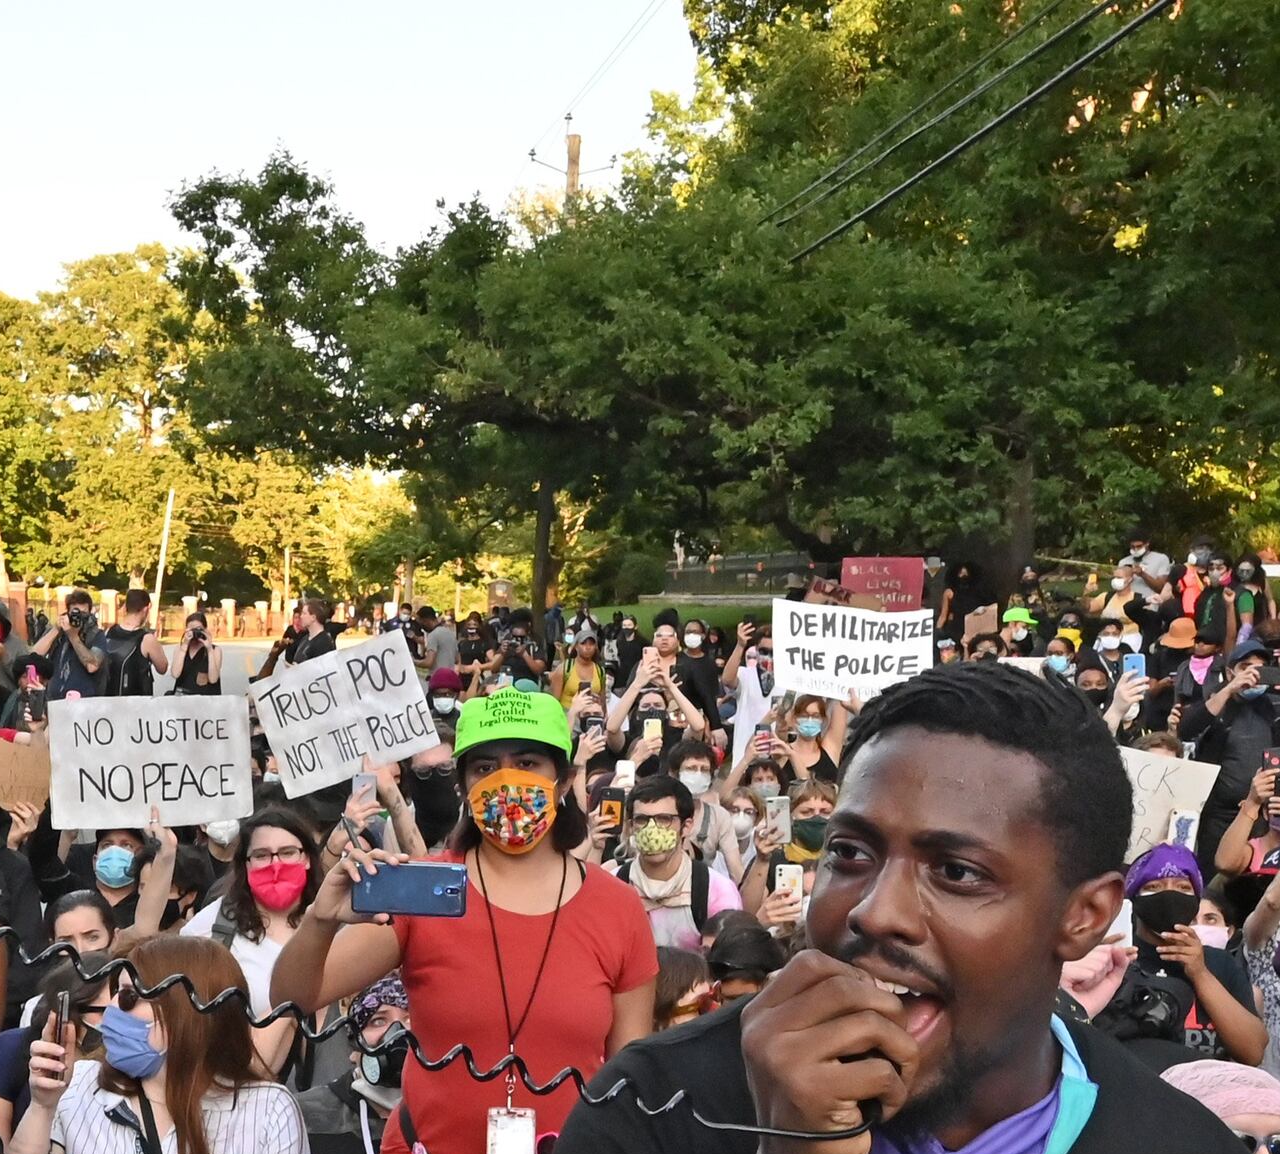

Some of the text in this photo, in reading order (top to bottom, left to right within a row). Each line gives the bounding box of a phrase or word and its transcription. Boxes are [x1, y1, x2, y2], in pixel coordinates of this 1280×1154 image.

[866, 579, 902, 590] LIVES
[790, 611, 934, 643] DEMILITARIZE
[786, 647, 918, 676] THE POLICE
[258, 648, 406, 728] TRUST POC
[486, 690, 532, 702] National
[484, 700, 532, 711] Lawyers
[492, 706, 525, 718] Guild
[73, 717, 229, 747] NO JUSTICE
[479, 715, 539, 728] Legal Observer
[284, 736, 324, 779] NOT
[327, 723, 368, 763] THE
[79, 764, 135, 802] NO
[141, 763, 236, 804] PEACE
